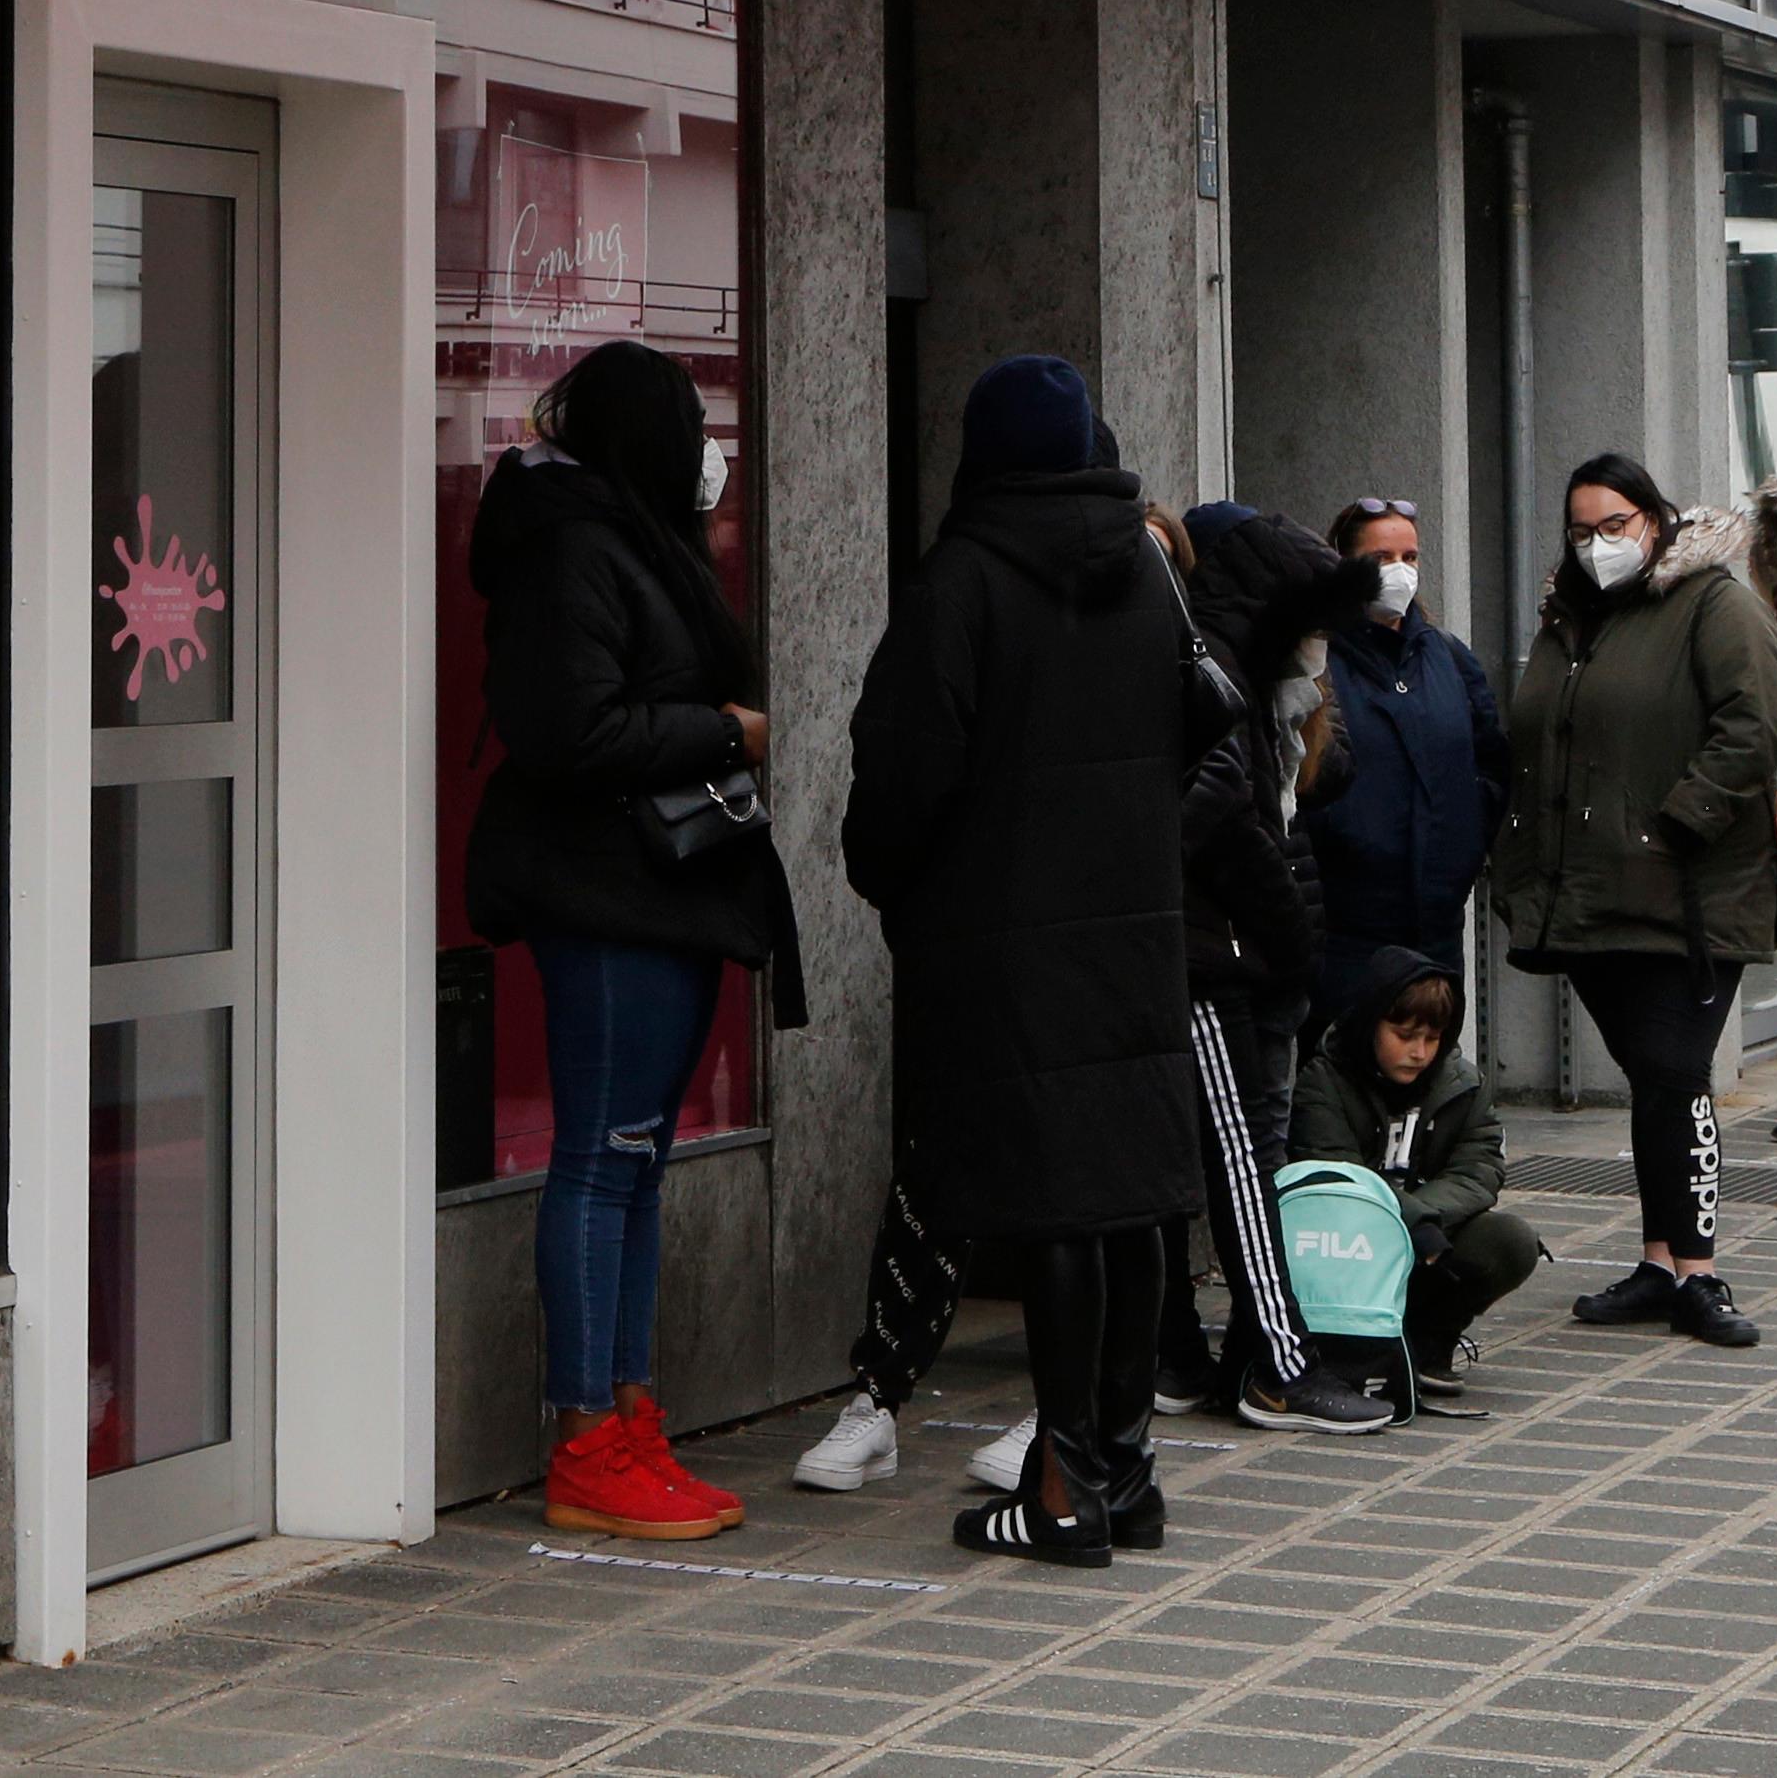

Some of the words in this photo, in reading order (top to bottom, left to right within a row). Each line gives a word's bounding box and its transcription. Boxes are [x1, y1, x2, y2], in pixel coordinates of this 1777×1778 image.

[507, 203, 629, 319] Coming
[1689, 1093, 1720, 1238] adidas
[1295, 1230, 1375, 1262] FILA
